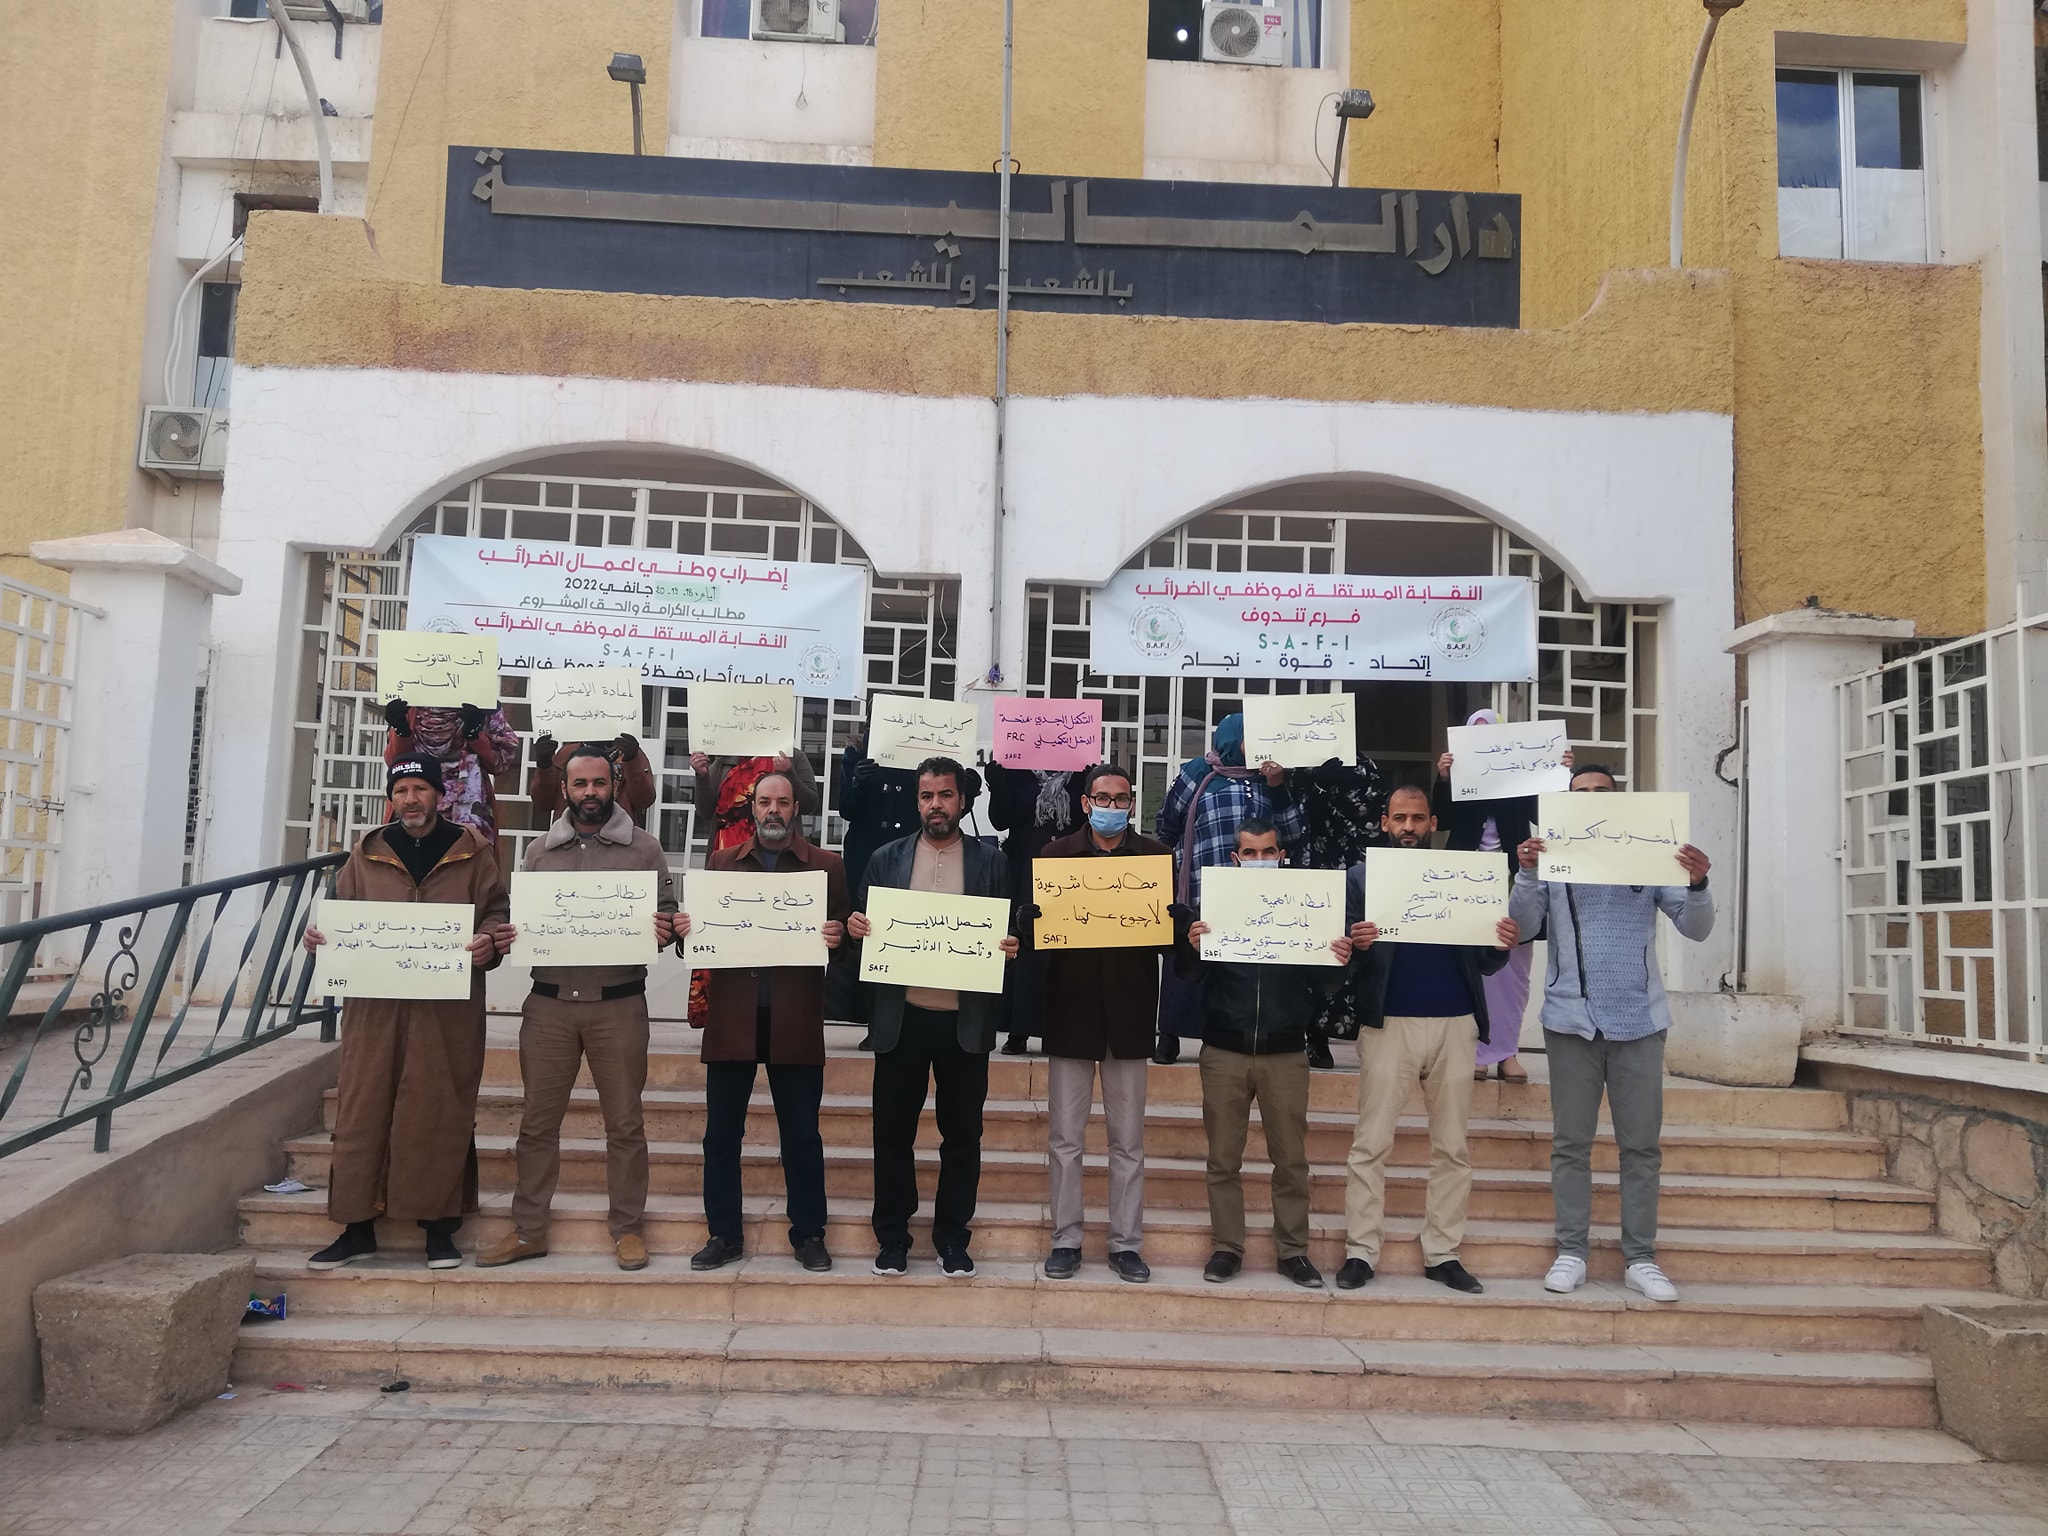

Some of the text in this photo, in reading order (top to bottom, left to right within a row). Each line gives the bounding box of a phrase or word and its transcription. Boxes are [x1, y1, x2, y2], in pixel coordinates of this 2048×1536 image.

[472, 148, 1512, 276] دار المالية
[984, 267, 1133, 306] بالشعب
[478, 545, 788, 590] إضراب وطني لعمال الضرائب
[565, 577, 597, 591] 2022
[599, 581, 653, 598] جانفي
[1135, 577, 1482, 604] النقابة المستقلة لموظفي الضرائب
[519, 593, 746, 621] مطالب الكرامة والحق المشروع
[474, 612, 543, 632] الضرائب
[1241, 606, 1361, 627] فرع تندوف
[545, 620, 626, 639] لموظفي
[628, 625, 716, 644] المستقلة
[719, 632, 788, 649] النقابة
[403, 650, 484, 667] أين القانون
[1181, 651, 1240, 671] نجاح
[1279, 653, 1333, 672] قوة
[1369, 655, 1432, 677] إتحاد
[1006, 732, 1026, 742] FRC
[1255, 754, 1272, 762] SAFI
[1461, 788, 1478, 796] SAFI
[1549, 865, 1572, 875] SAFI
[772, 890, 814, 911] قطاع
[1042, 934, 1068, 945] SAFI
[1378, 927, 1399, 936] SAFI
[692, 945, 716, 953] SAFI
[868, 963, 890, 973] SAFI
[327, 978, 348, 988] SAFI
